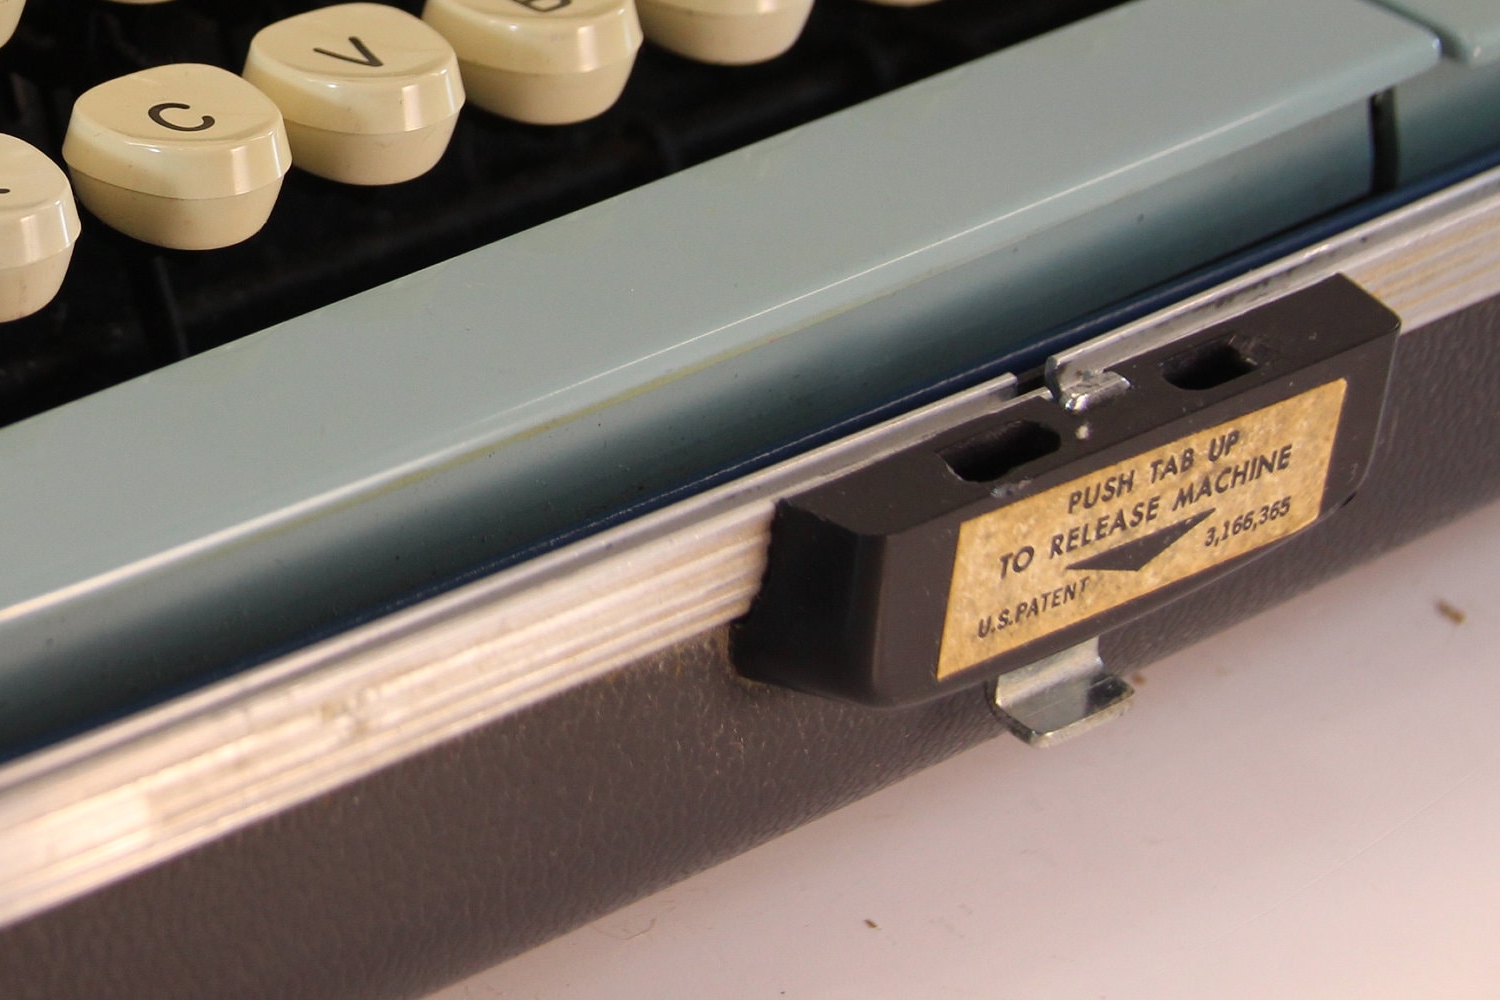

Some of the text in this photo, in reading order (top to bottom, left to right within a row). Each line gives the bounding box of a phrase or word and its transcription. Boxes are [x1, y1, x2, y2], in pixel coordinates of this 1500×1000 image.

[311, 35, 385, 69] V
[146, 101, 217, 133] C
[1066, 430, 1241, 515] PUSH TAB UP
[1000, 444, 1293, 579] TO RELEASE MACHINE
[1204, 496, 1292, 547] 3,166,365
